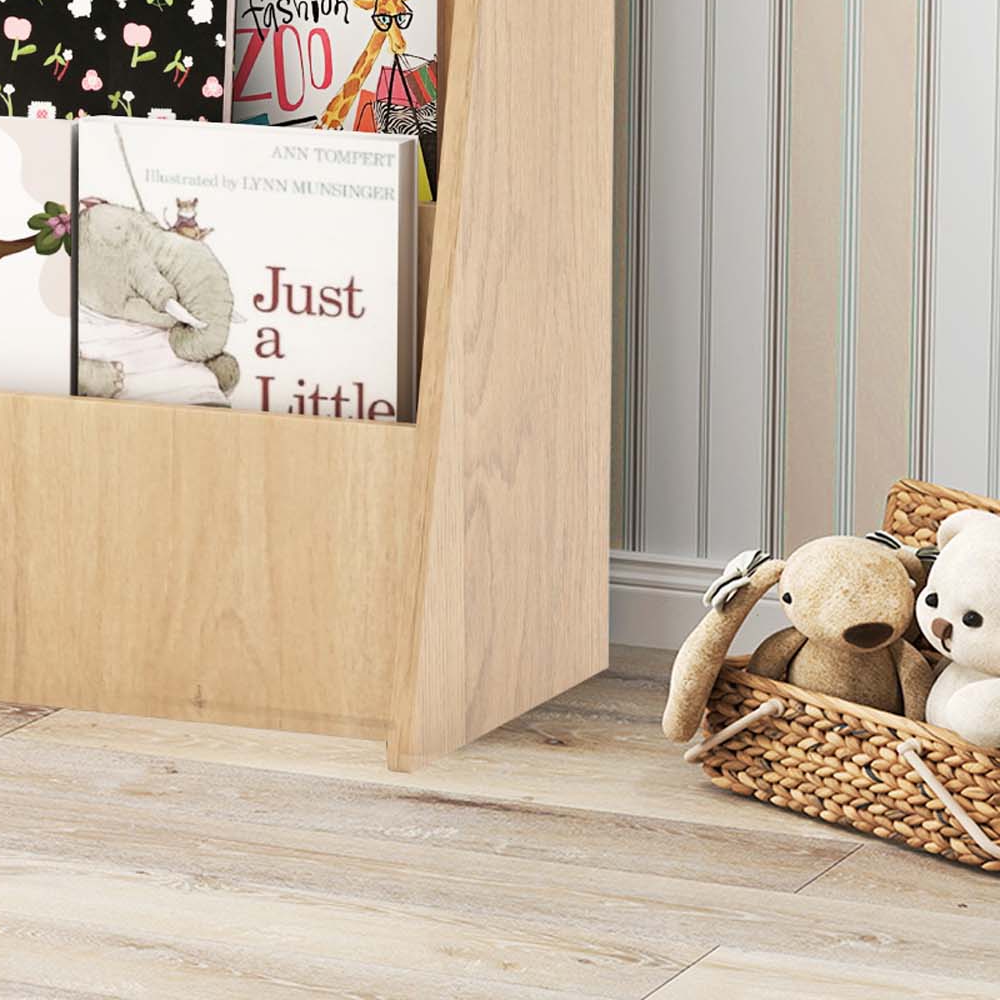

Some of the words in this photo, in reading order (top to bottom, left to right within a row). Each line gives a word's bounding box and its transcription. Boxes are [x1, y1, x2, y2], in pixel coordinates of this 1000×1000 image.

[271, 145, 309, 161] ANN
[313, 147, 396, 168] TOMPERT
[145, 168, 219, 188] Illustrated
[221, 176, 237, 192] by
[242, 177, 288, 193] LYNN
[292, 180, 395, 201] MUNSINGER
[253, 265, 366, 320] Just
[254, 326, 285, 360] a
[255, 375, 396, 421] Little
